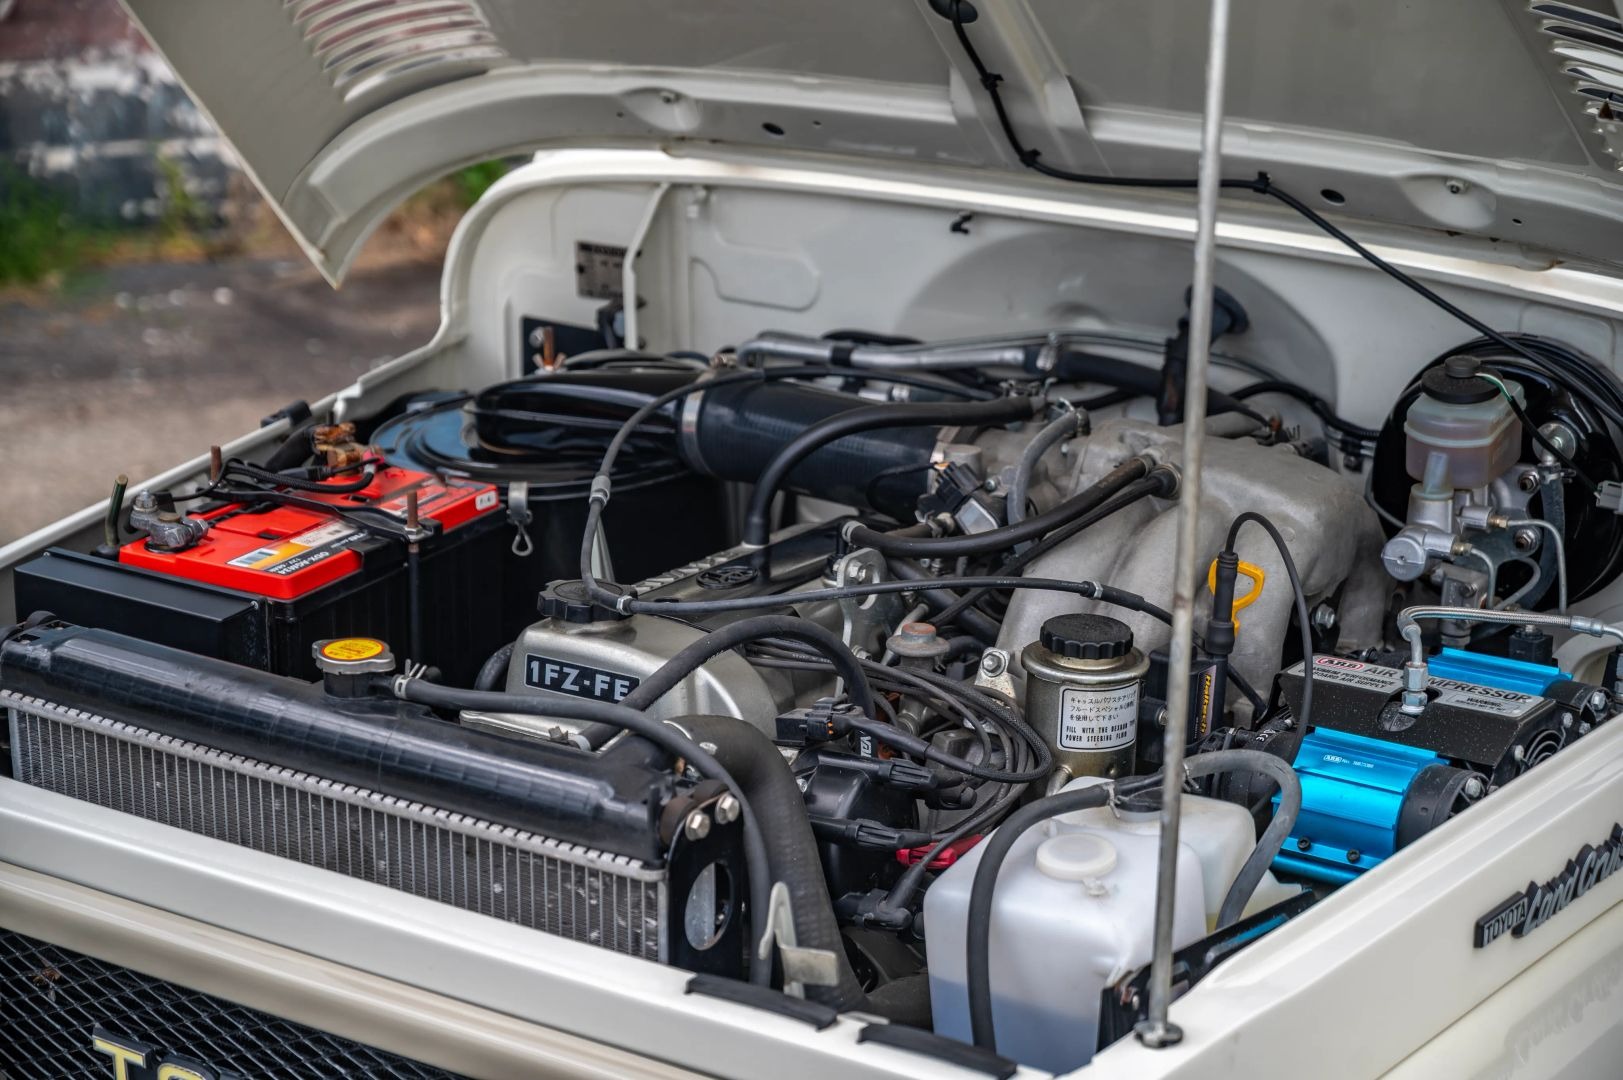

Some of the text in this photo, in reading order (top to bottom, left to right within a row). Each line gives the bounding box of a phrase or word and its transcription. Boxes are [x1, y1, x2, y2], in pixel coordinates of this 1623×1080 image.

[530, 660, 630, 701] 1FZ-FE
[1364, 666, 1399, 678] AIR
[1428, 678, 1532, 702] MPRESSOR
[1201, 674, 1211, 733] Haltech
[1065, 734, 1083, 742] POWER
[1087, 734, 1112, 742] STEERING
[1066, 725, 1076, 734] FILL
[1098, 726, 1108, 734] THE
[1484, 898, 1527, 945] TOYOTA
[1521, 866, 1580, 936] Land
